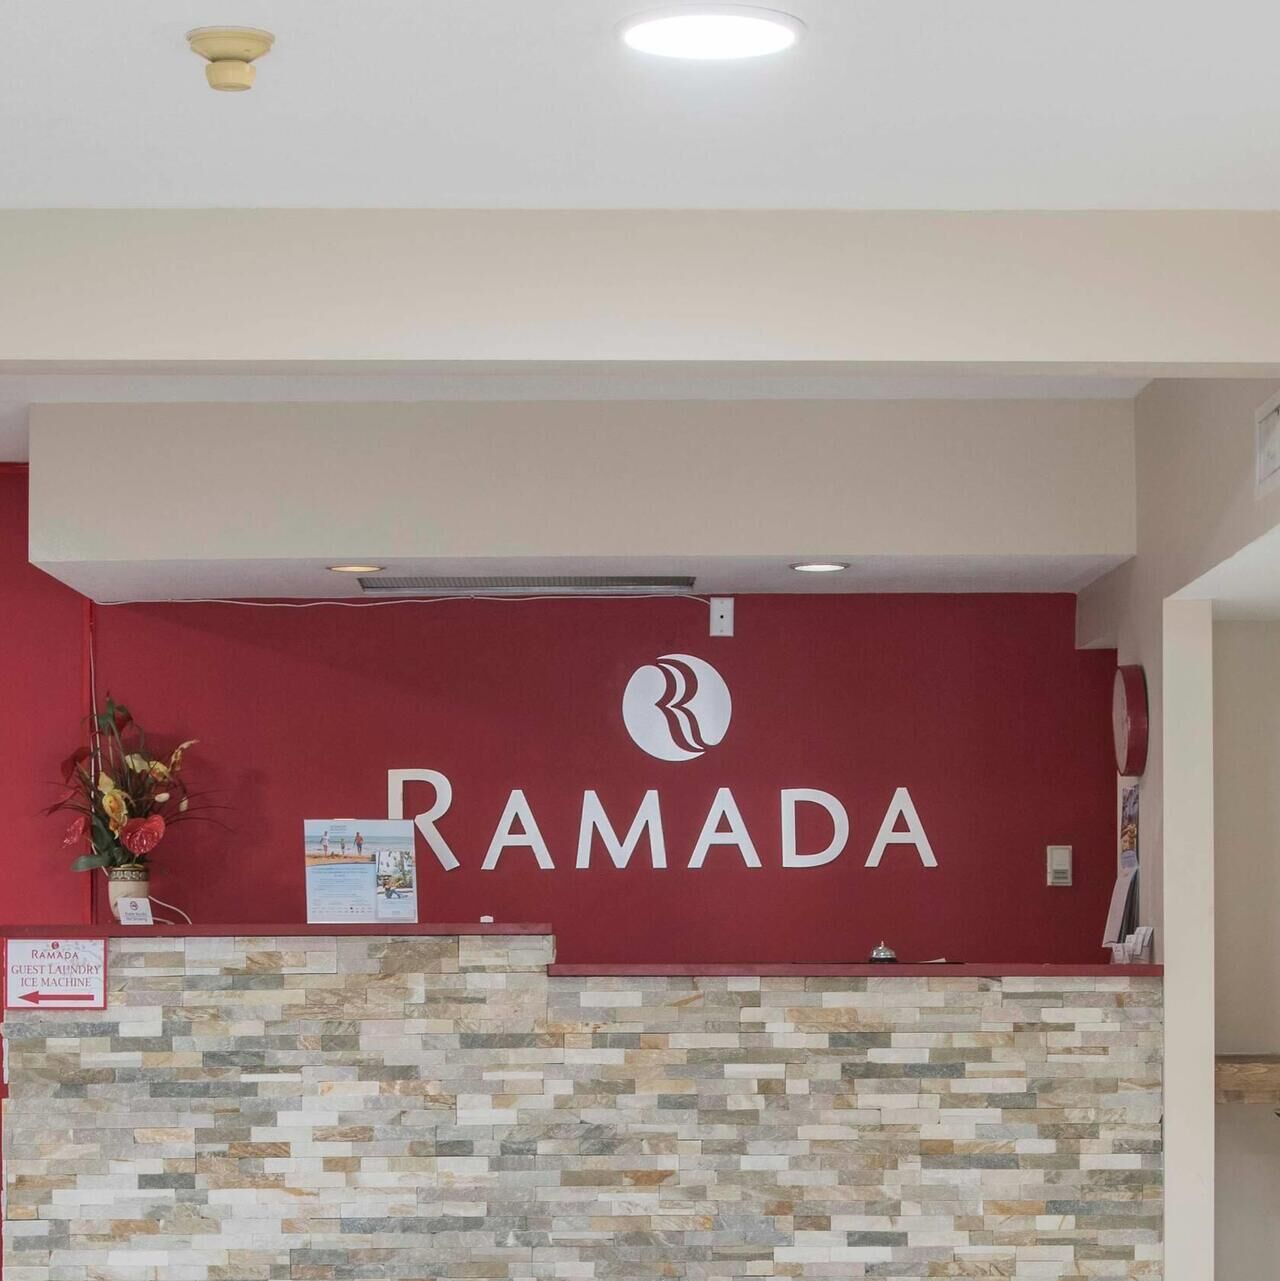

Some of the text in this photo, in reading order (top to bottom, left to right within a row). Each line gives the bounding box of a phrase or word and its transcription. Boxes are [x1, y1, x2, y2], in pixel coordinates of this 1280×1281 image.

[387, 768, 938, 871] RAMADA
[31, 949, 79, 960] RAMADA
[11, 965, 100, 975] GUEST LAUNDRY
[20, 977, 92, 987] ICE MACHINE
